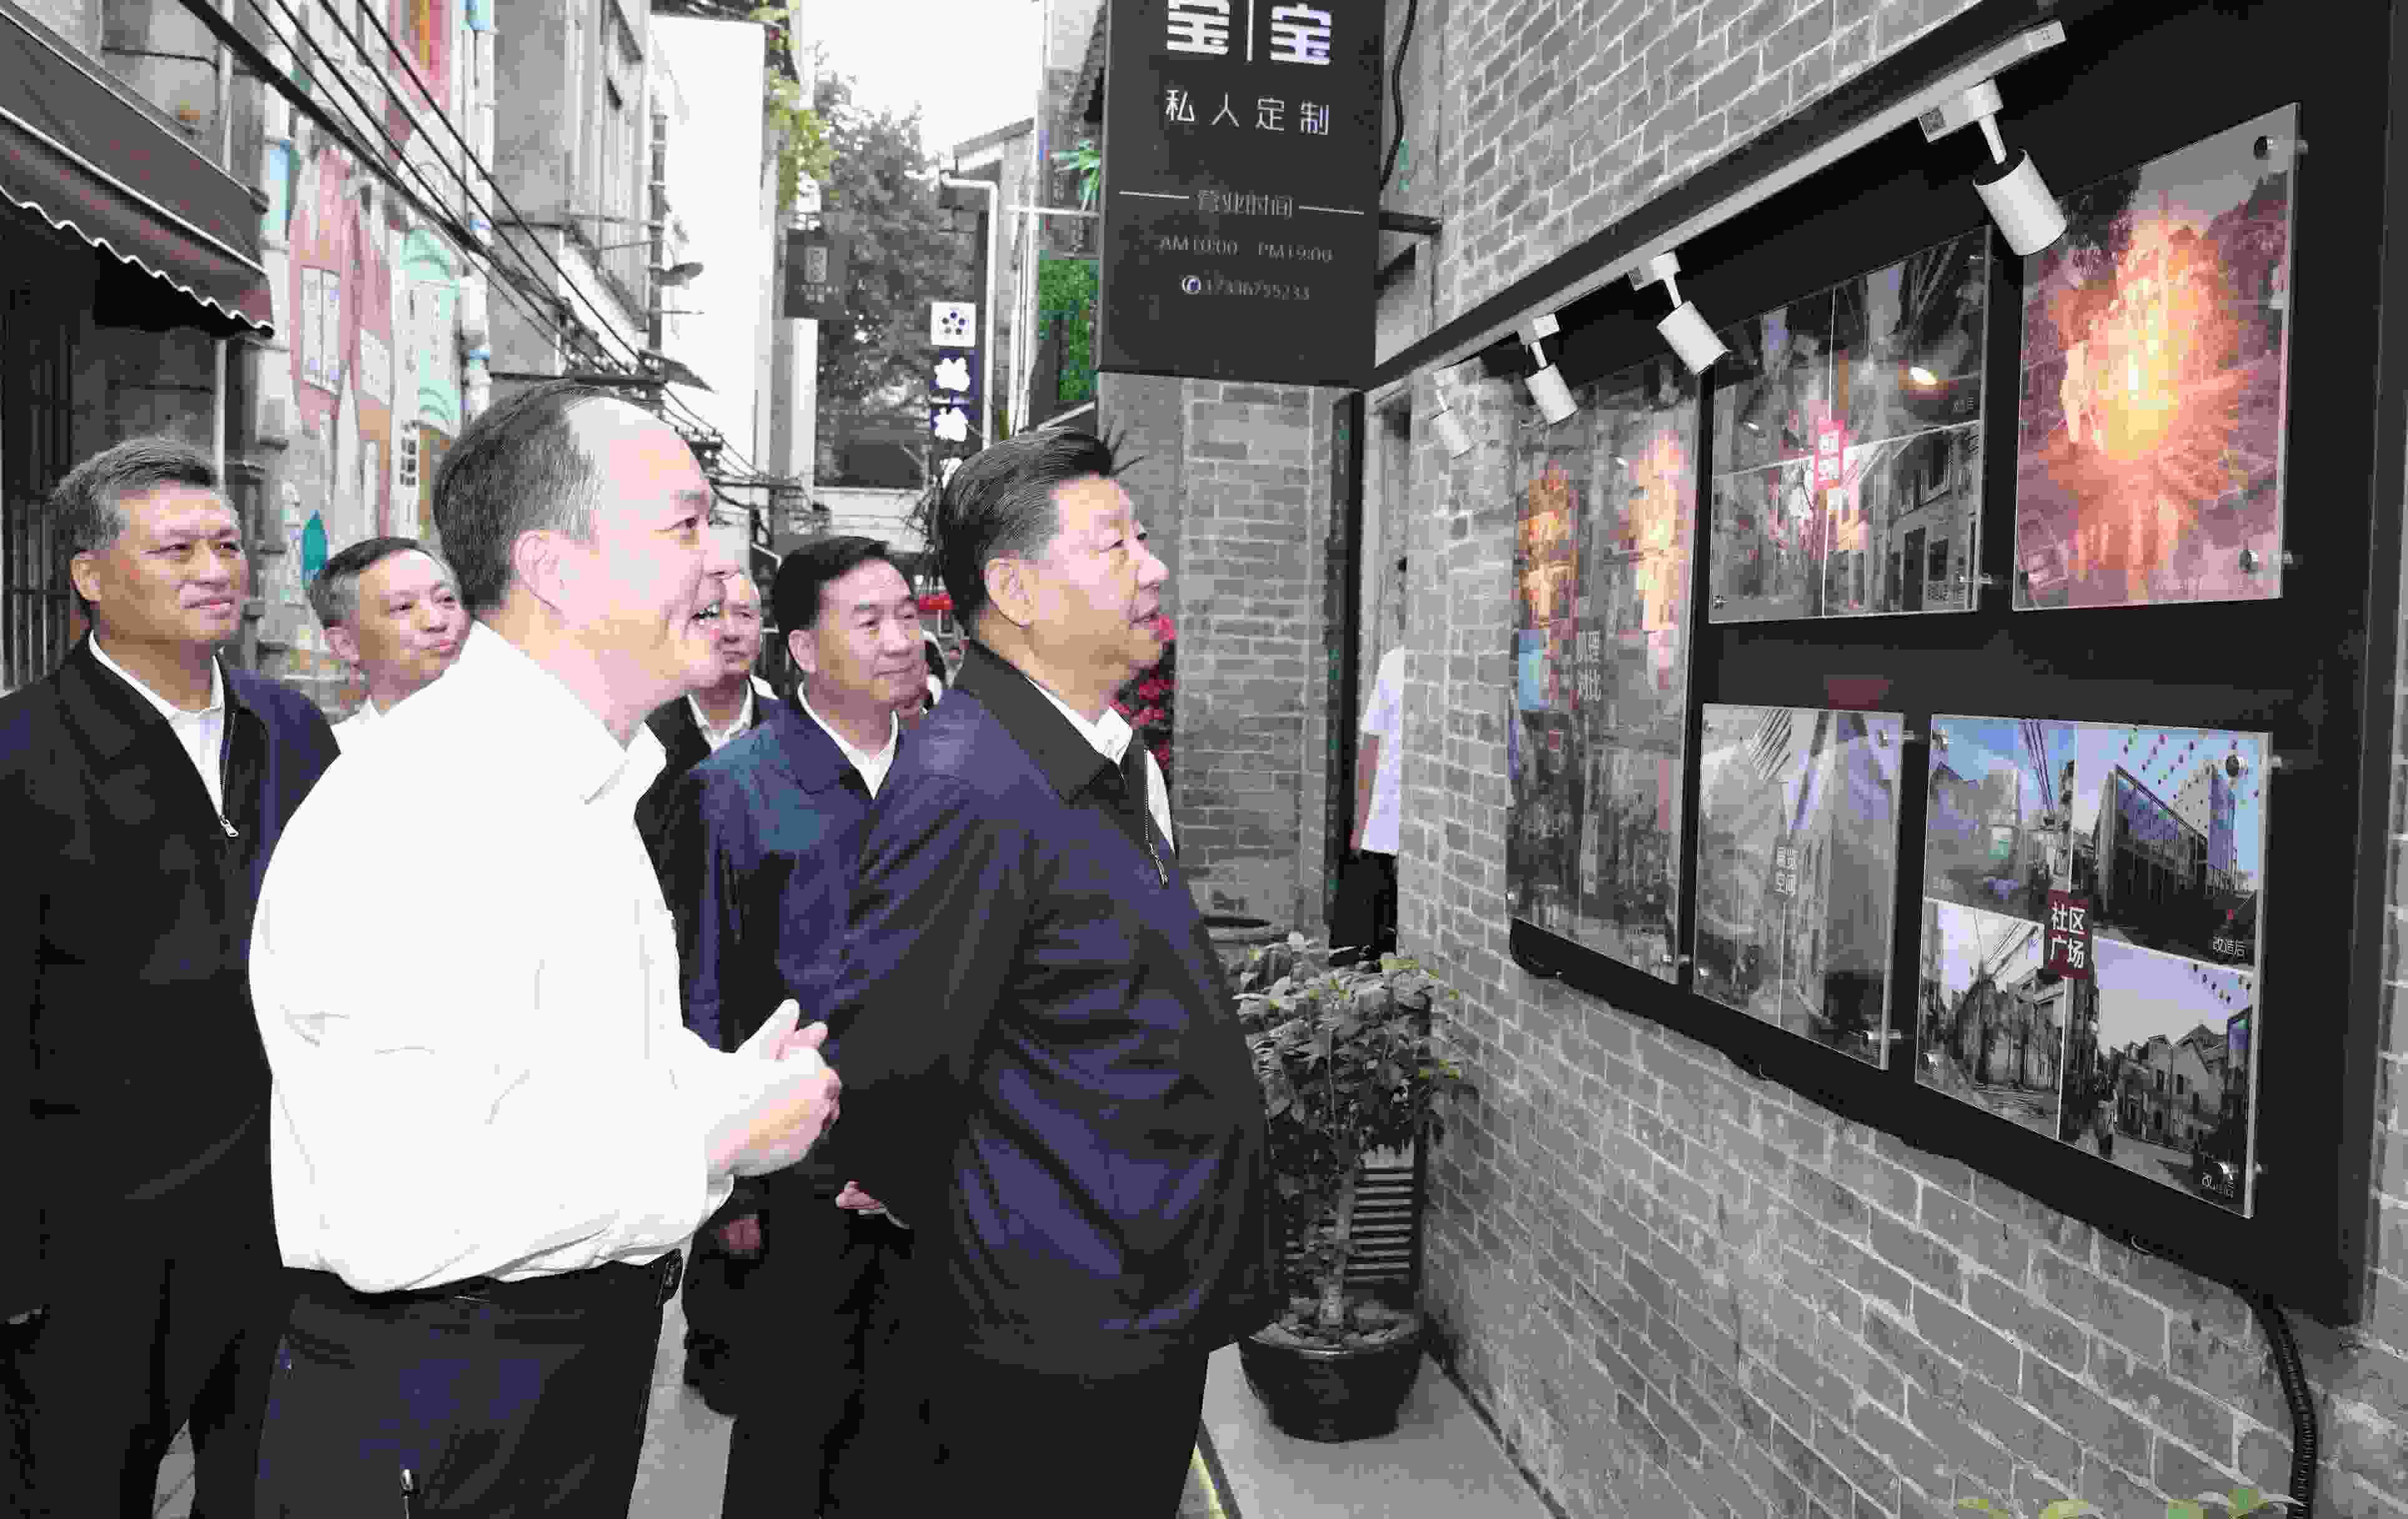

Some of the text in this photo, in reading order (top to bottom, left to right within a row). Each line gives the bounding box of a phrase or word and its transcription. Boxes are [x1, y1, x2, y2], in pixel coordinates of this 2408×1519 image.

[1270, 2, 1331, 65] 宝
[1165, 89, 1330, 135] 私人定制
[2051, 899, 2086, 935] 社区
[2050, 934, 2085, 969] 广场
